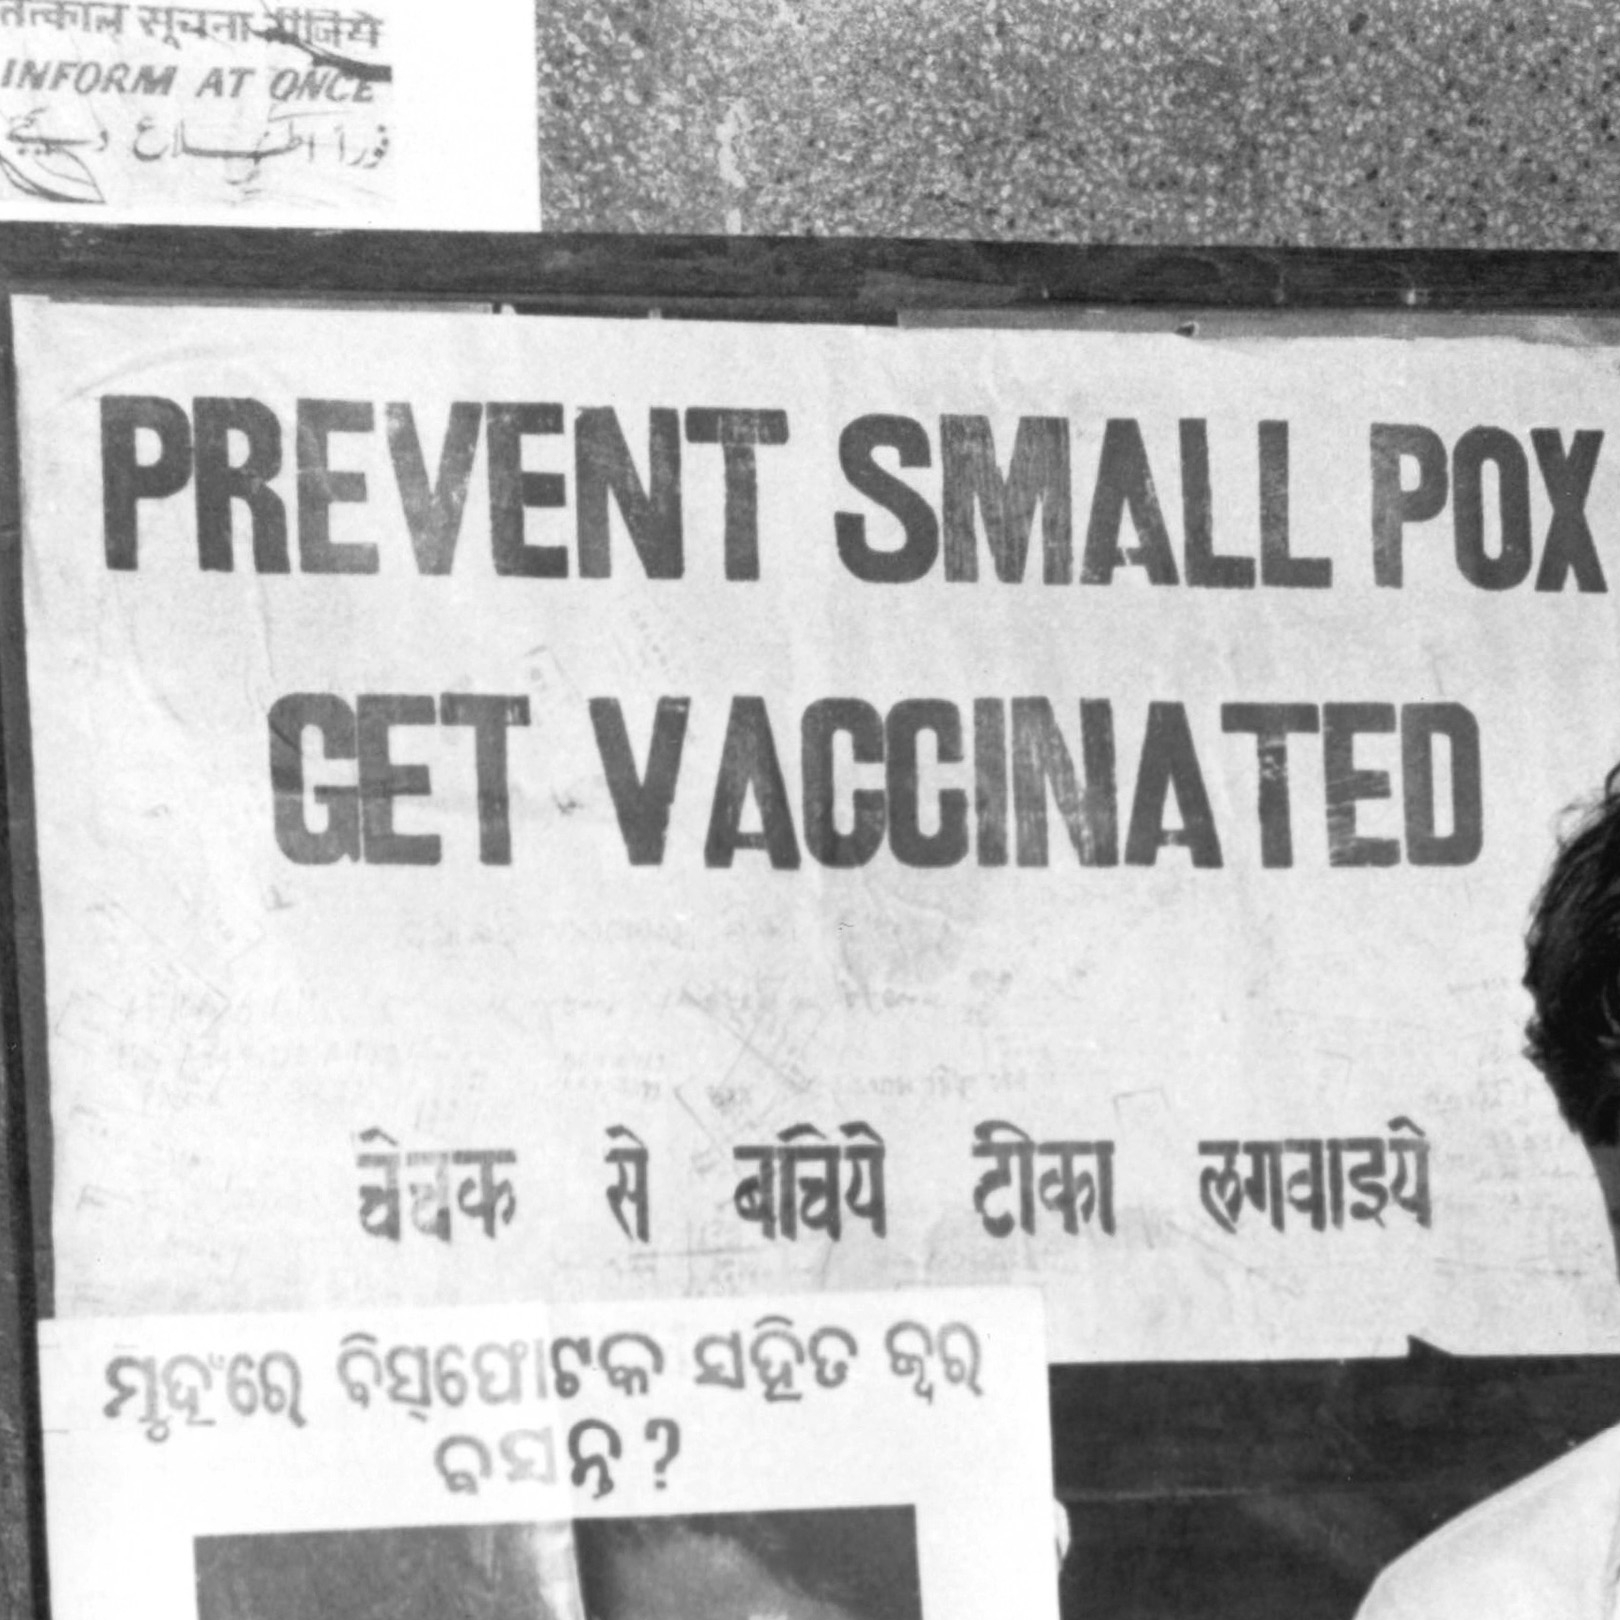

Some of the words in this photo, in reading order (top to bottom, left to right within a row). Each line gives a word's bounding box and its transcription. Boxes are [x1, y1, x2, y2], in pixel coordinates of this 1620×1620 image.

[0, 58, 178, 97] INFORM
[194, 67, 257, 99] AT
[268, 66, 375, 103] ONCE
[138, 4, 251, 49] सूचना
[99, 395, 790, 582] PREVENT
[833, 413, 1333, 590] SMALL
[1369, 423, 1609, 595] POX
[266, 692, 531, 868] GET
[588, 695, 1484, 873] VACCINATED
[357, 1128, 518, 1244] चेचक
[604, 1124, 650, 1244] से
[971, 1119, 1118, 1240] टीका
[1197, 1116, 1433, 1236] लगवाइये
